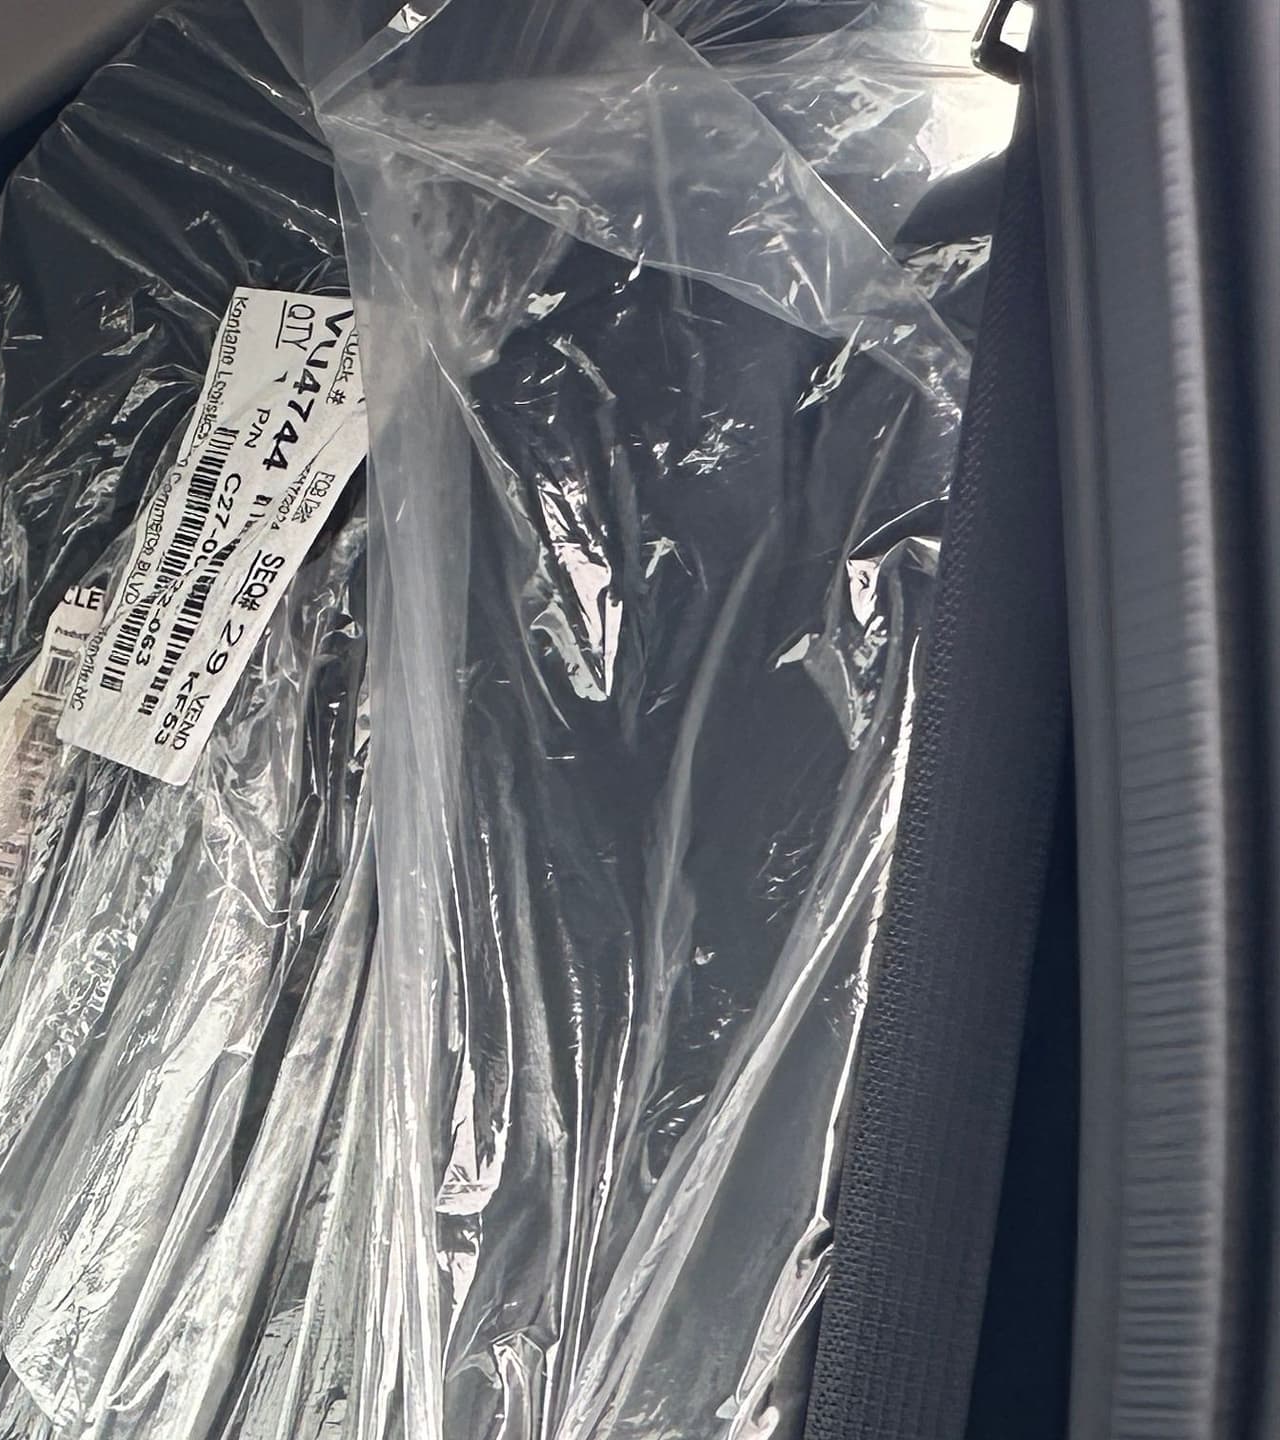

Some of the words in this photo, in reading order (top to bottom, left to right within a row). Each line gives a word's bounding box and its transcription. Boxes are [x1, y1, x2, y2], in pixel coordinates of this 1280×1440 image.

[281, 303, 315, 352] QTY
[335, 327, 358, 383] ruck
[262, 310, 353, 471] VU4744
[330, 389, 346, 406] #
[243, 408, 270, 449] P/N
[124, 560, 149, 606] BLVD
[236, 553, 285, 612] SEQ#
[205, 620, 244, 675] 29
[153, 672, 199, 746] KF53
